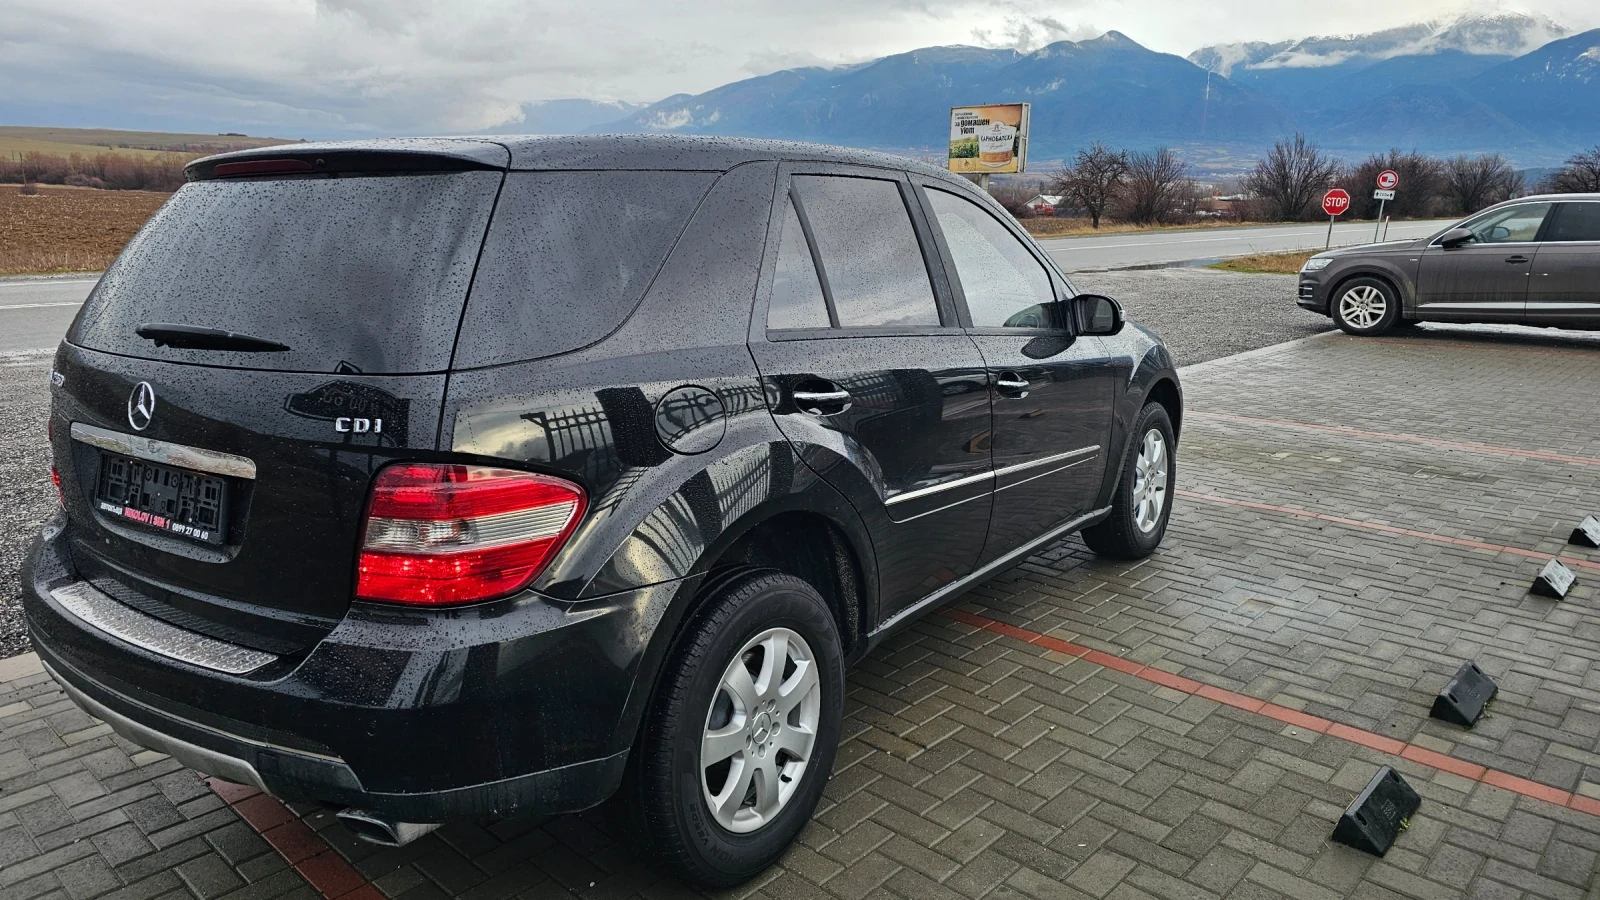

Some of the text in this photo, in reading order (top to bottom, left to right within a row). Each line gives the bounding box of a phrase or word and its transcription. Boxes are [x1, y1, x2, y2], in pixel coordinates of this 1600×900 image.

[1325, 197, 1347, 207] STOP
[335, 417, 382, 433] CDI
[172, 522, 186, 533] 0899
[185, 526, 193, 535] 27
[193, 528, 201, 538] 00
[200, 531, 209, 540] 60
